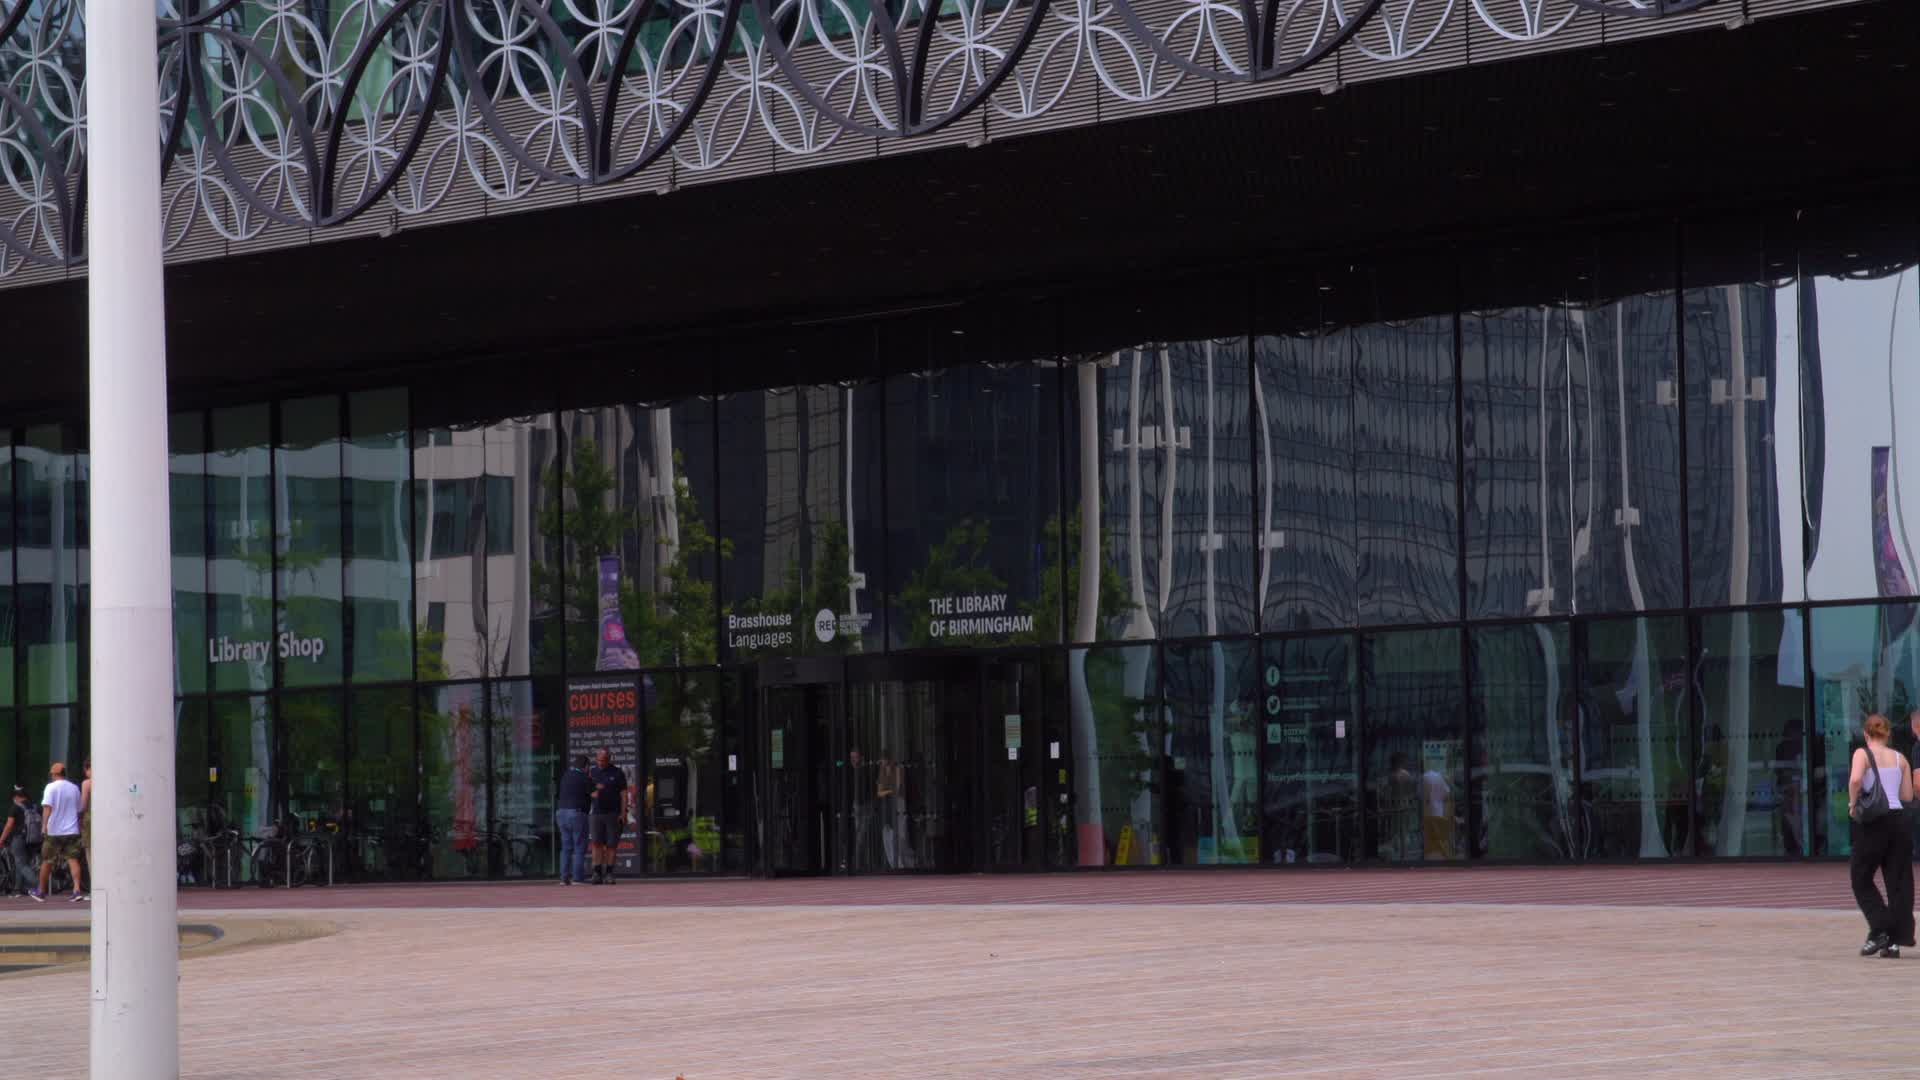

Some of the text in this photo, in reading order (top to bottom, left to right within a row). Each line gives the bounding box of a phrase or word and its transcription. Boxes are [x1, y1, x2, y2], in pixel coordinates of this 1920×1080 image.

[929, 594, 1007, 615] THE LIBRARY
[728, 612, 792, 629] Brasshouse
[929, 616, 1033, 637] OF BIRMINGHAM
[209, 631, 324, 665] Library Shop
[728, 631, 792, 649] Languages
[569, 691, 636, 711] courses
